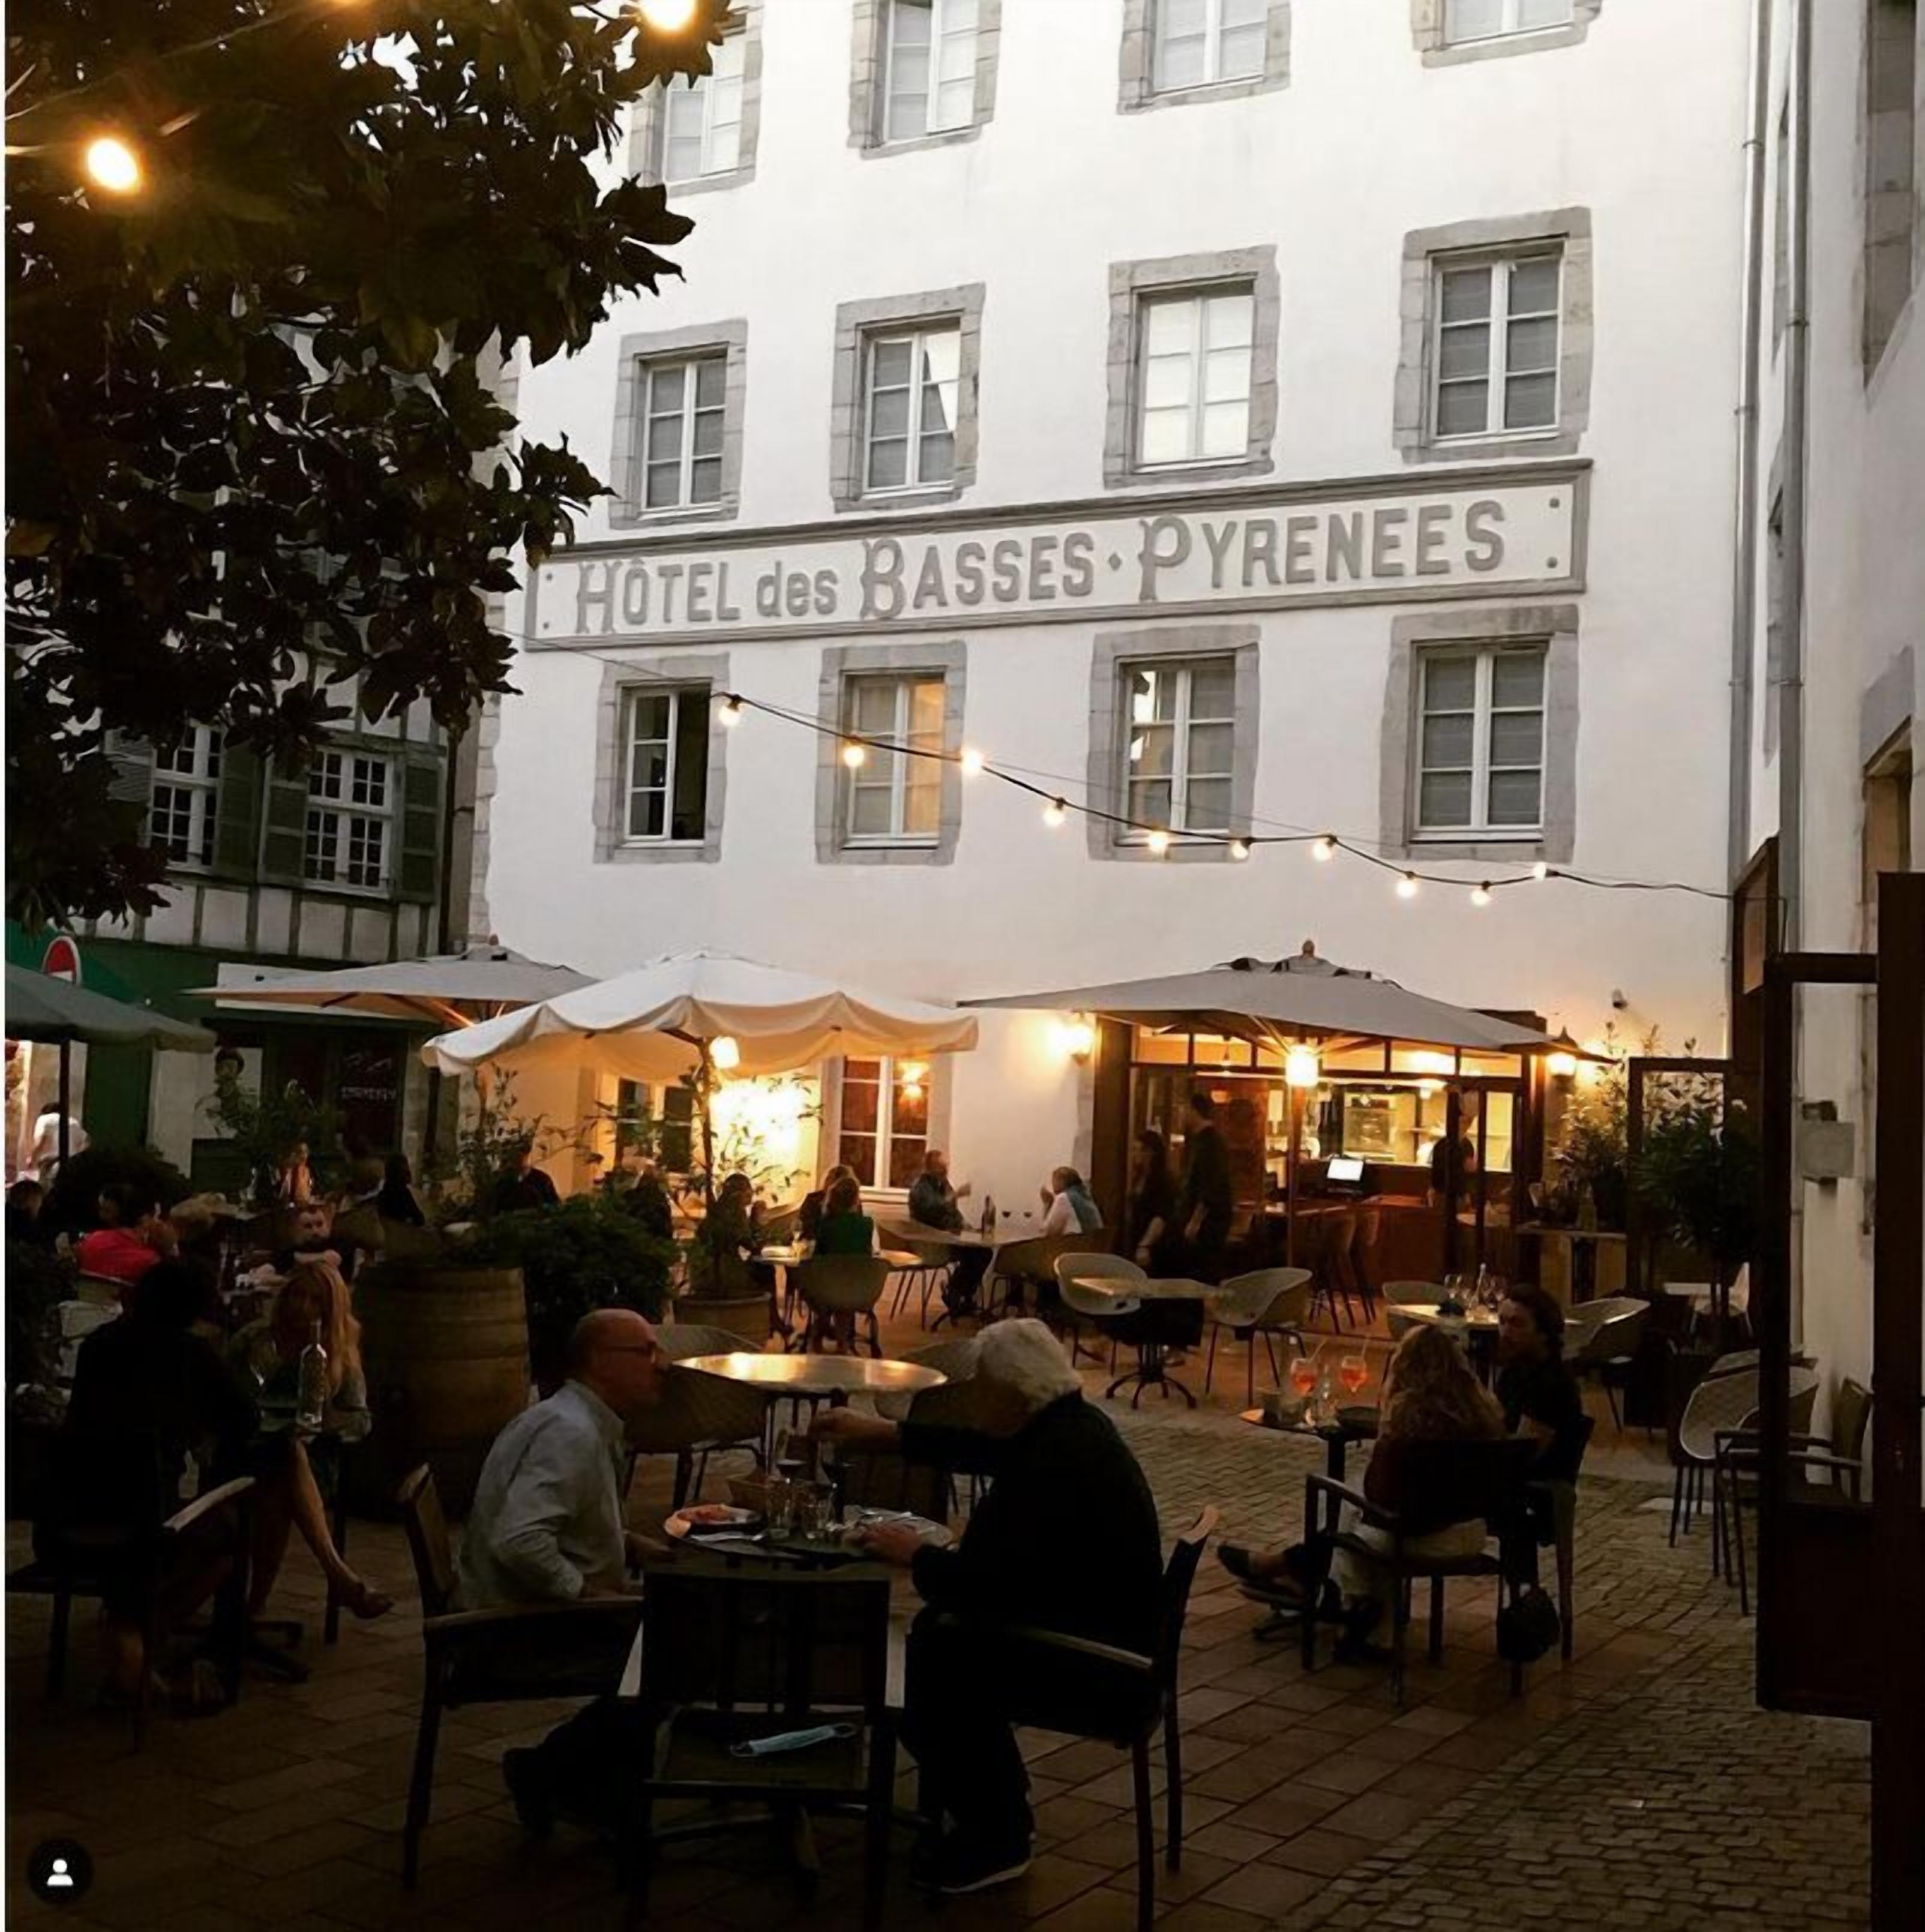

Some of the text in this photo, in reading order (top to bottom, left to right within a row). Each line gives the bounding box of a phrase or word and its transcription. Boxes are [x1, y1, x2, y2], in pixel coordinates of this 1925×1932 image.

[576, 500, 1506, 634] HÔTEL des BASSES PYRENEES
